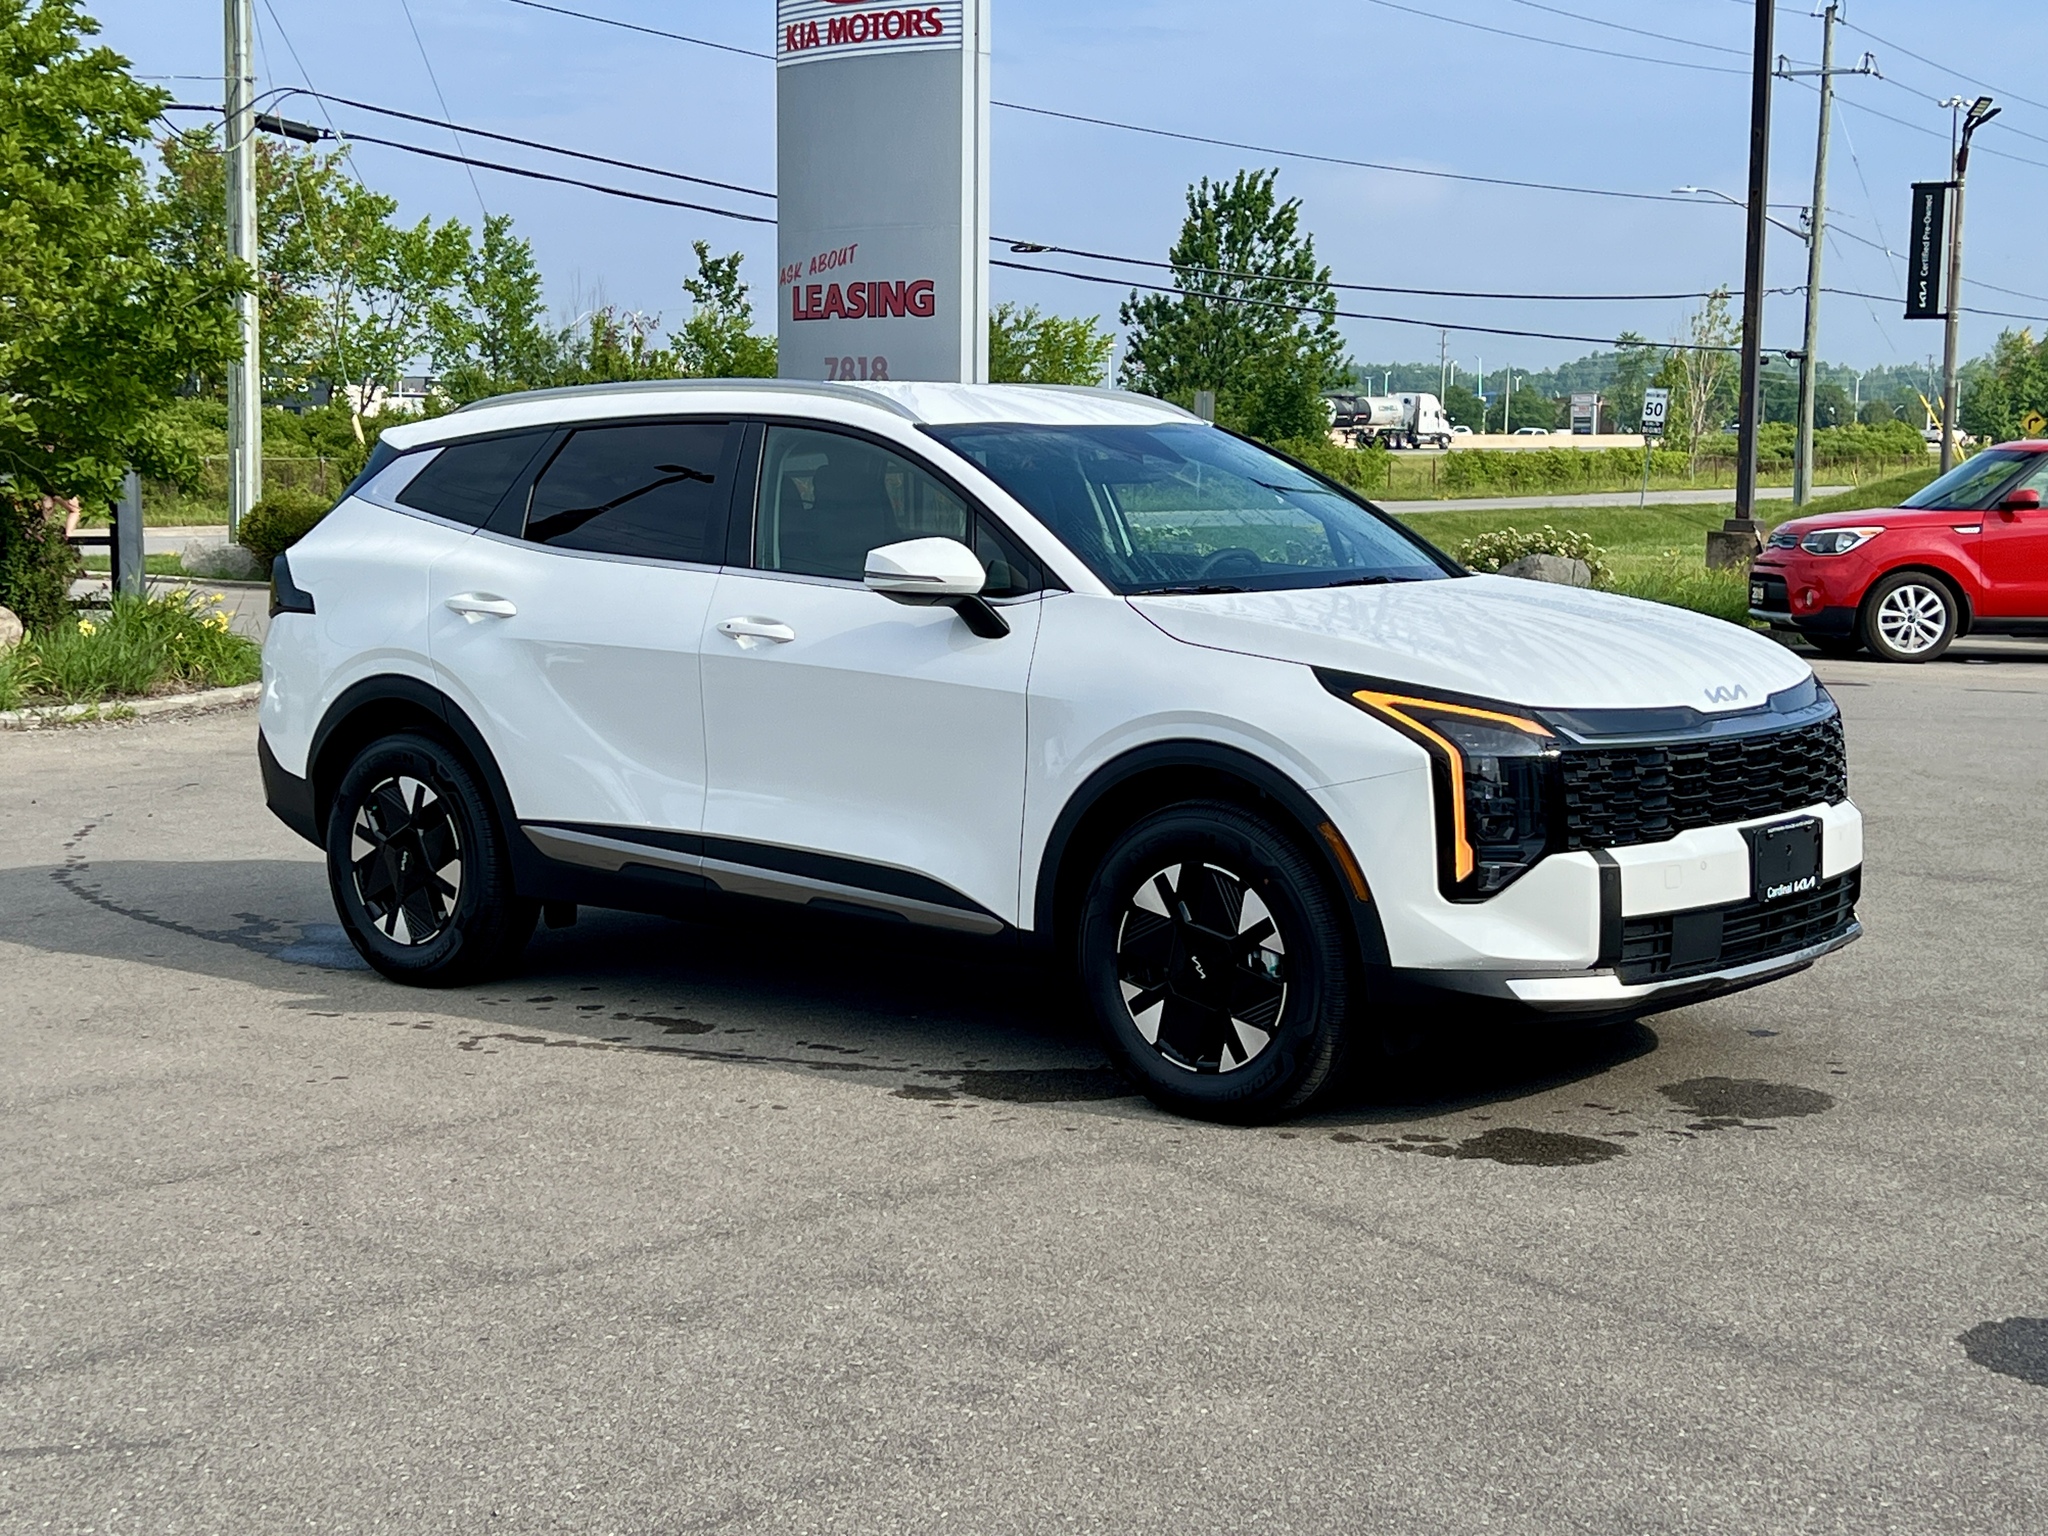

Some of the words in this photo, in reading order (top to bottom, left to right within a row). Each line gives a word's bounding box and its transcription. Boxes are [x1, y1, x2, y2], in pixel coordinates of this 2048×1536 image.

[786, 20, 821, 51] KIA
[827, 7, 943, 46] MOTORS
[1922, 195, 1932, 240] Pre-Owned
[779, 261, 803, 286] ASK
[809, 243, 859, 276] ABOUT
[1920, 241, 1931, 277] Certified
[792, 279, 936, 321] LEASING
[824, 356, 890, 381] 7818
[1645, 402, 1663, 416] 50
[1704, 683, 1748, 703] KIA
[1767, 882, 1793, 898] Cardinal
[1794, 875, 1816, 892] KIA
